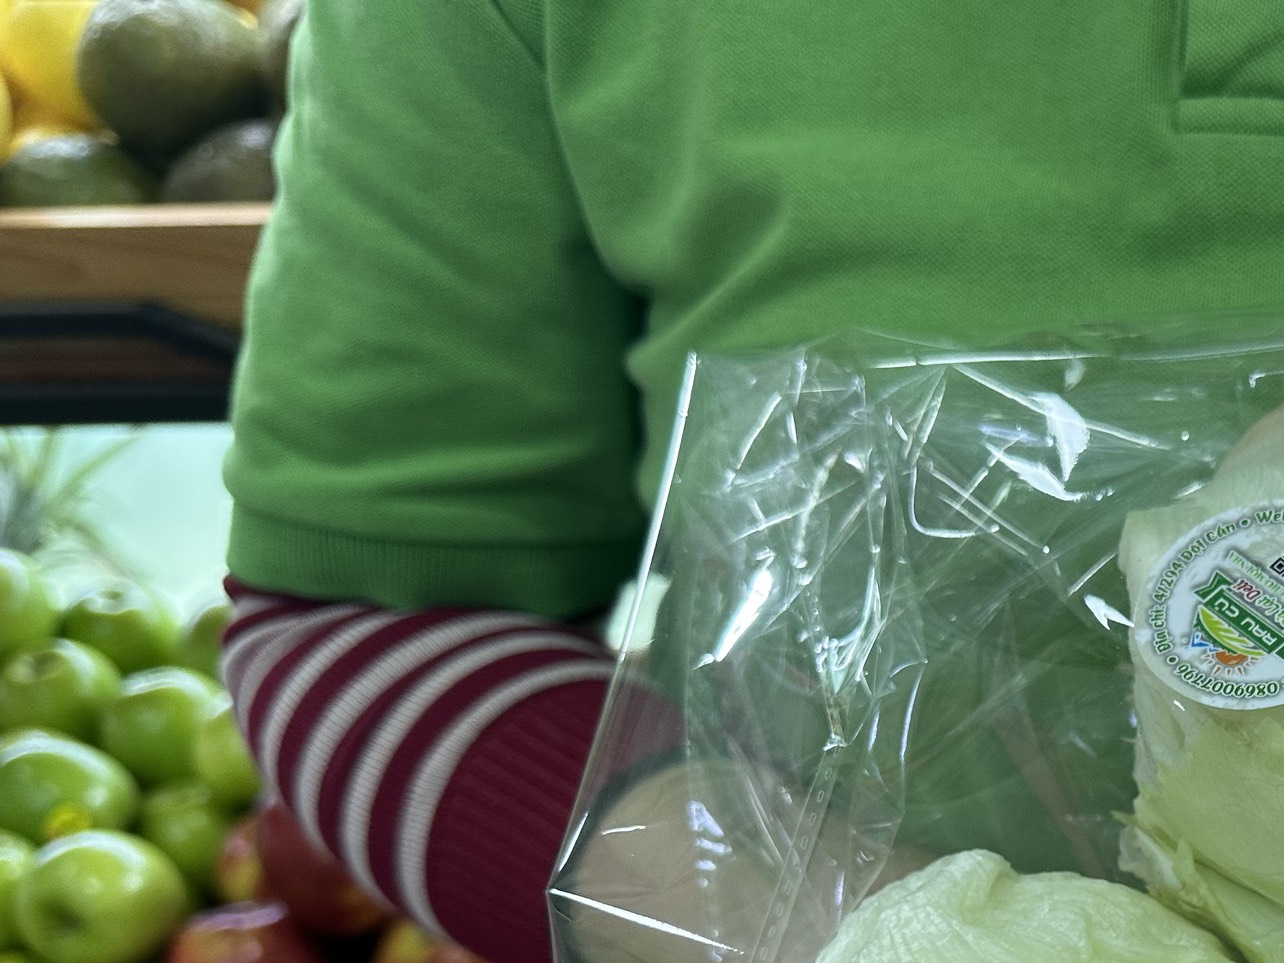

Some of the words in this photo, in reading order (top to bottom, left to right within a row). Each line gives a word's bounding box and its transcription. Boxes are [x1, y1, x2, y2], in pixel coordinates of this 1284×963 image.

[1153, 561, 1182, 603] 4/294
[1232, 579, 1261, 602] Deli
[1214, 598, 1239, 618] CỦ
[1240, 618, 1277, 646] RAU
[1175, 663, 1280, 698] 0869007796
